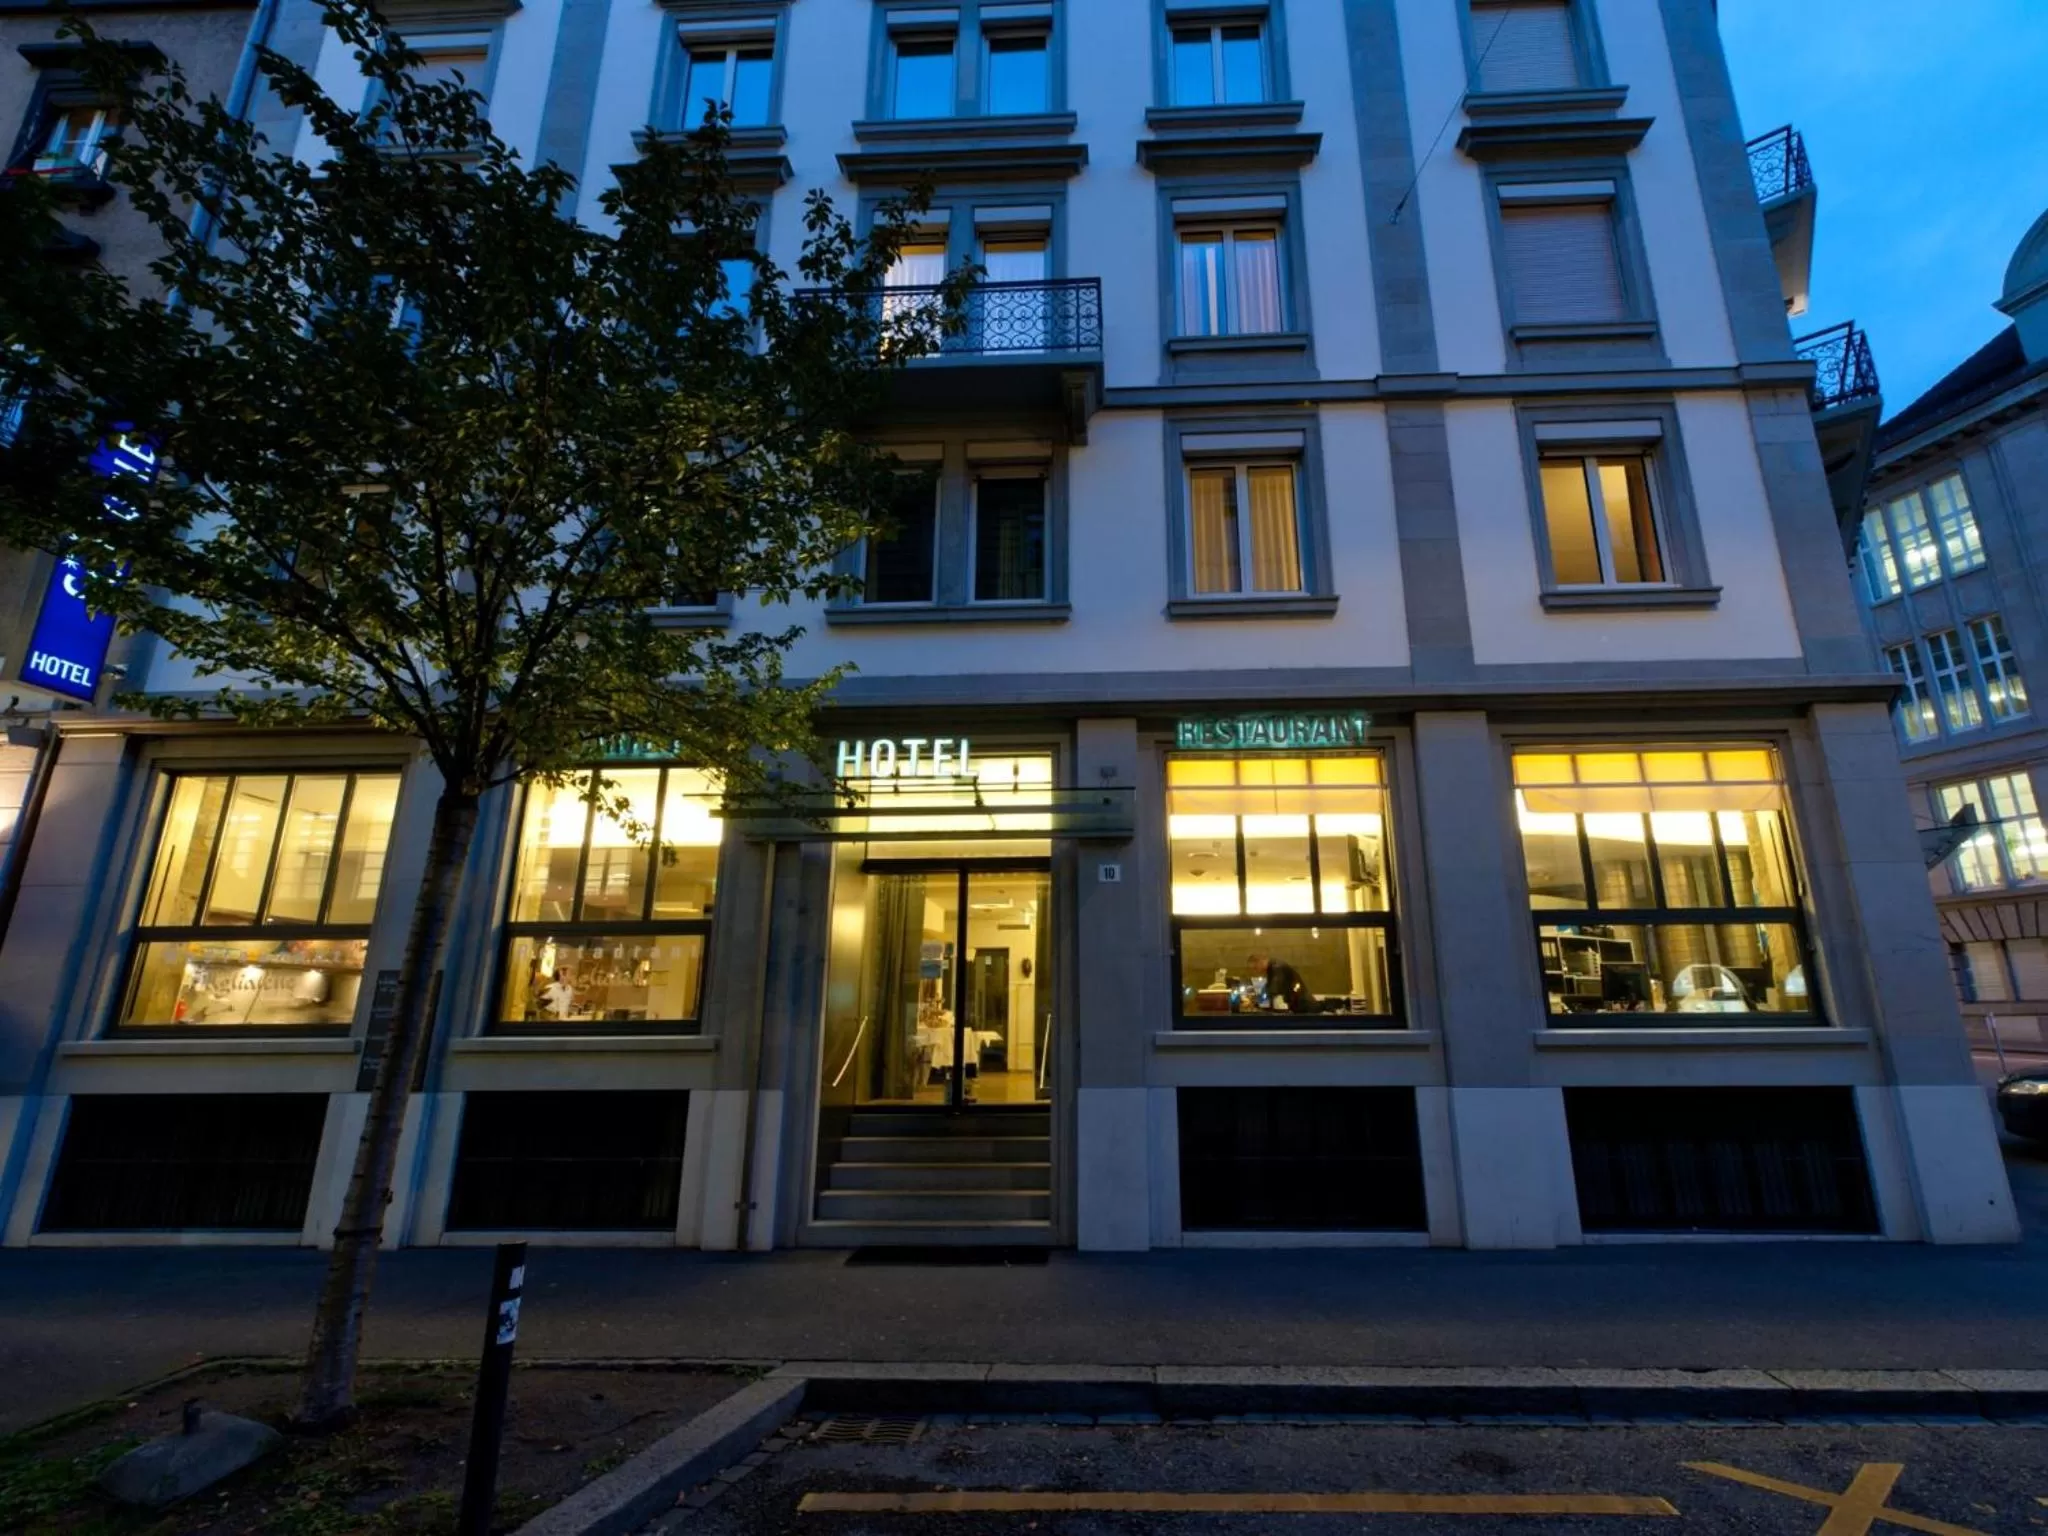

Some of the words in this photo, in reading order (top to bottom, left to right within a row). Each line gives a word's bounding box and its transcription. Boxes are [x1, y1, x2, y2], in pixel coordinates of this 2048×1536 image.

[30, 651, 91, 687] HOTEL
[1177, 713, 1369, 748] RESTAURANT
[836, 738, 978, 778] HOTEL
[1104, 867, 1115, 880] 10
